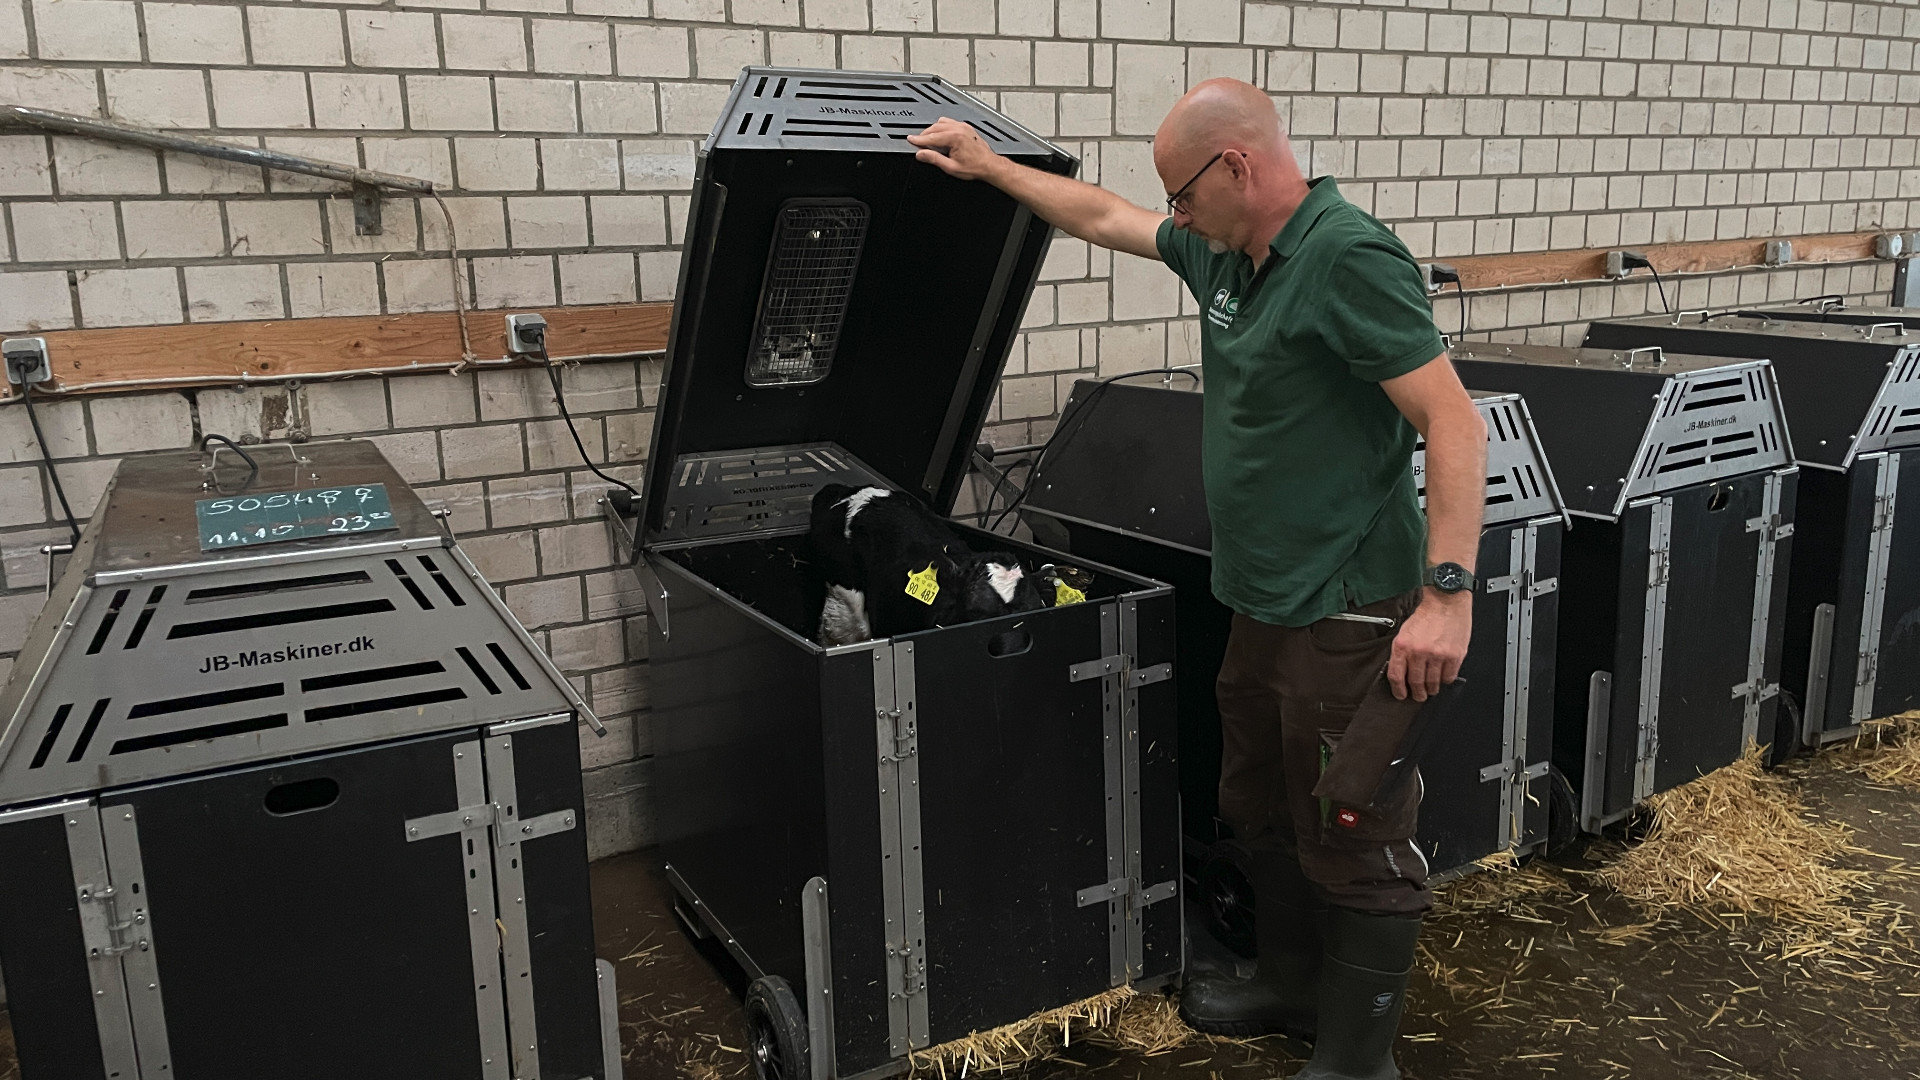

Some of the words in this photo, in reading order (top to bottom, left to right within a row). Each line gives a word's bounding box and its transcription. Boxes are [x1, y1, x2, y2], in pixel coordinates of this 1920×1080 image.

[819, 106, 915, 117] JB-Maskiner.dk
[1684, 414, 1737, 433] JB-Maskiner.dk
[908, 582, 919, 595] 90
[920, 588, 935, 603] 487
[199, 636, 375, 674] JB-Maskiner.dk
